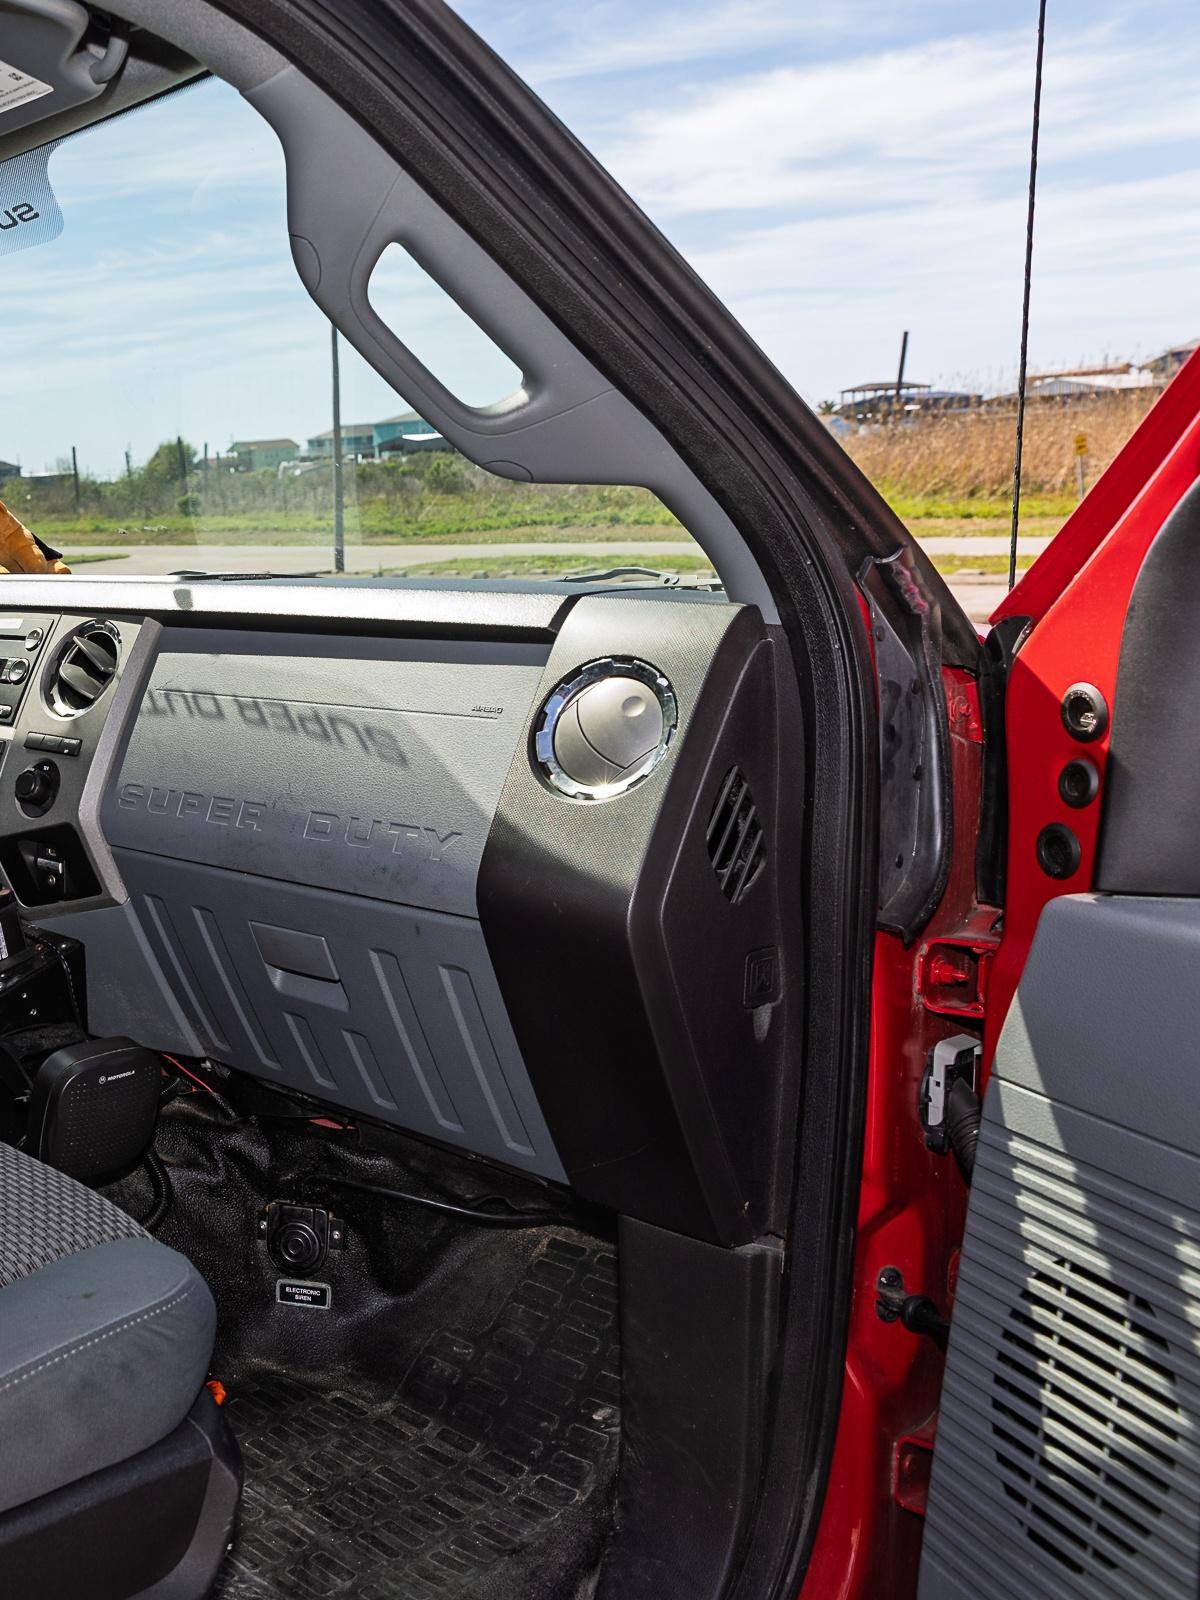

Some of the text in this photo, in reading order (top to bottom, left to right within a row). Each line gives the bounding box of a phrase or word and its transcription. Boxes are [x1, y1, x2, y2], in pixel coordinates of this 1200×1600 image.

[118, 783, 463, 861] SUPER DUTY
[107, 1070, 136, 1082] MOTOROLA
[285, 1286, 321, 1296] ELECTRONIC
[294, 1294, 312, 1302] SIREN
